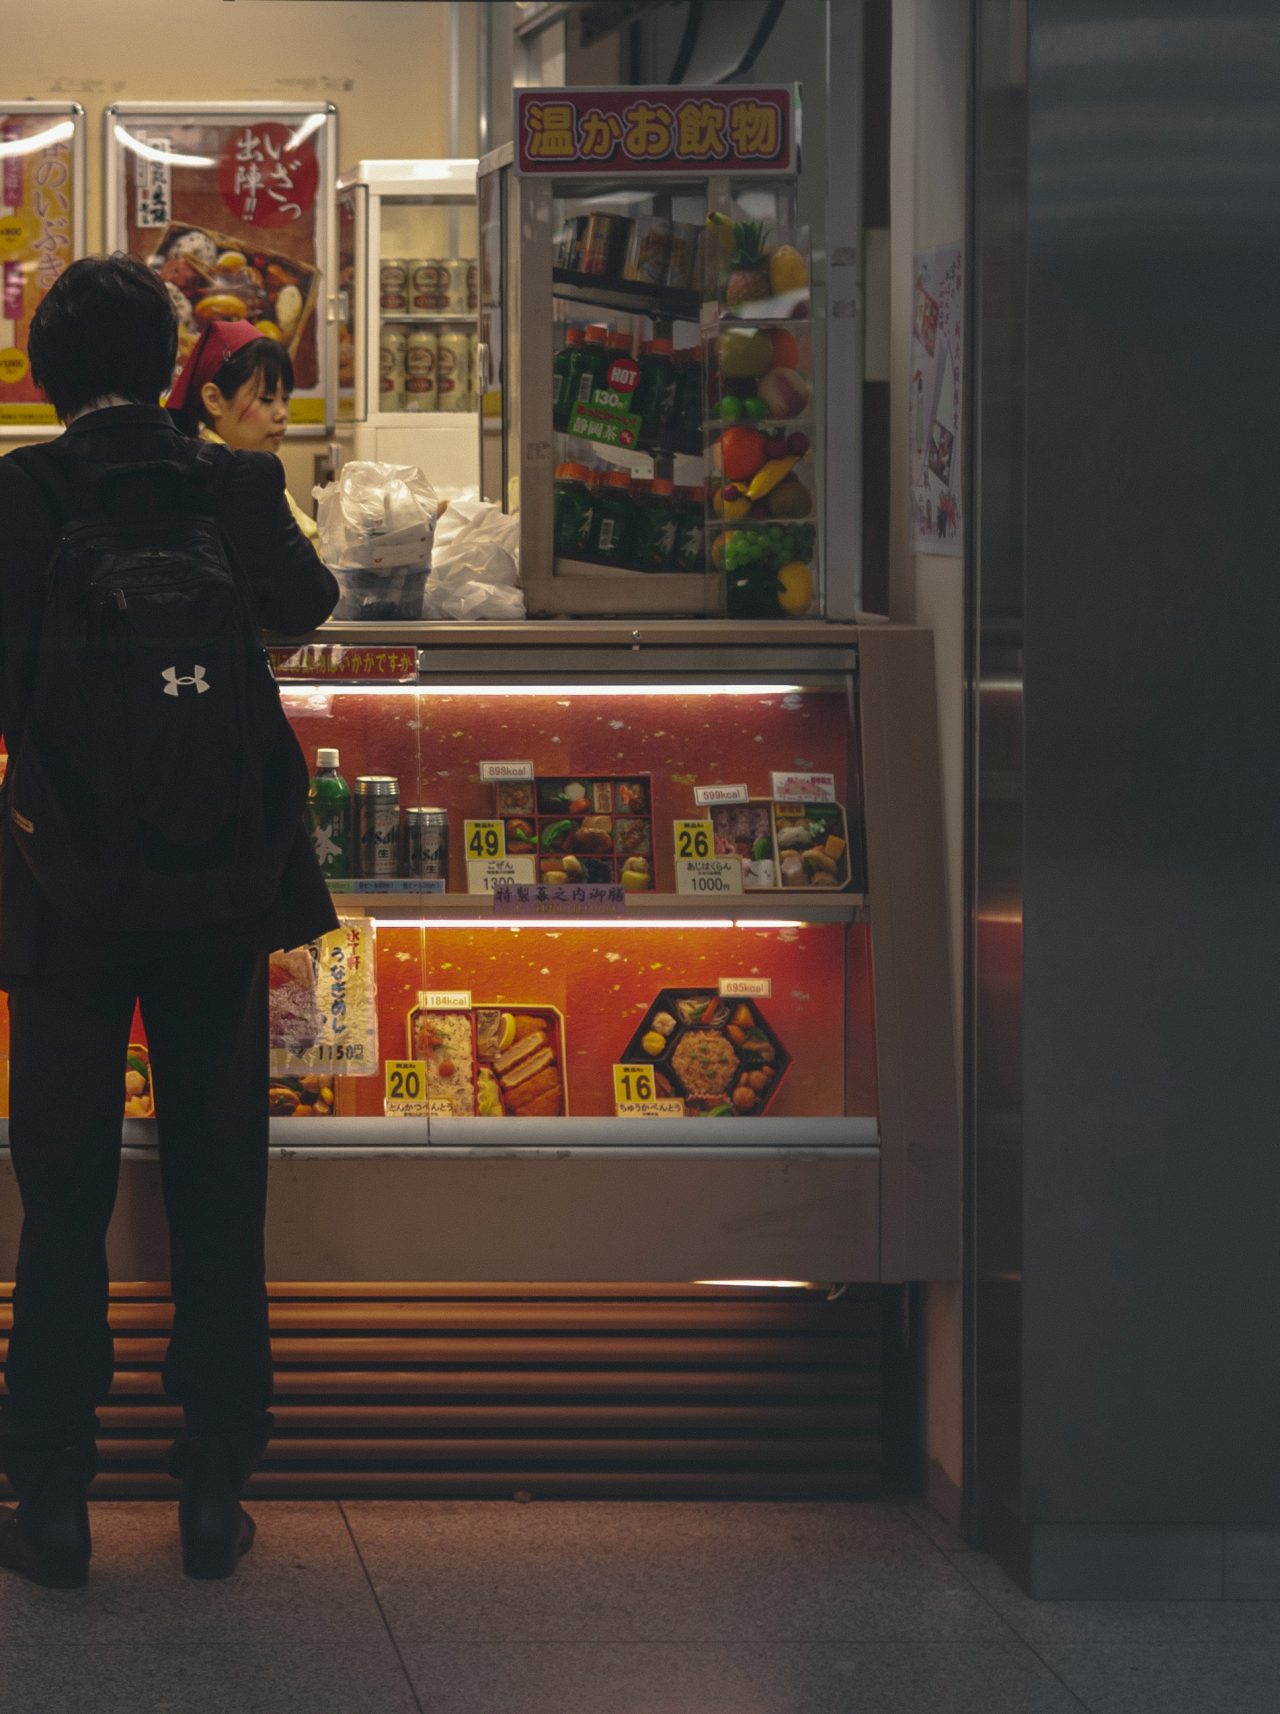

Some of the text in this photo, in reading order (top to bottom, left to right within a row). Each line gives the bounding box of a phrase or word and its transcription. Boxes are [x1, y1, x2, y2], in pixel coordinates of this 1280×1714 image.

[526, 102, 779, 158] 温かお飲物
[610, 366, 638, 387] HOT
[573, 417, 618, 441] 静岡茶
[488, 766, 527, 776] 898kcal
[703, 790, 741, 801] 599kcal
[470, 830, 499, 857] 49
[679, 831, 709, 858] 26
[488, 861, 514, 870] ごぜん
[691, 877, 731, 891] 1000円
[330, 946, 347, 1034] うなぎめし
[726, 983, 765, 993] 695kcal
[390, 1071, 420, 1098] 20
[621, 1074, 652, 1101] 16
[619, 1103, 681, 1112] ちゅうかべんとう
